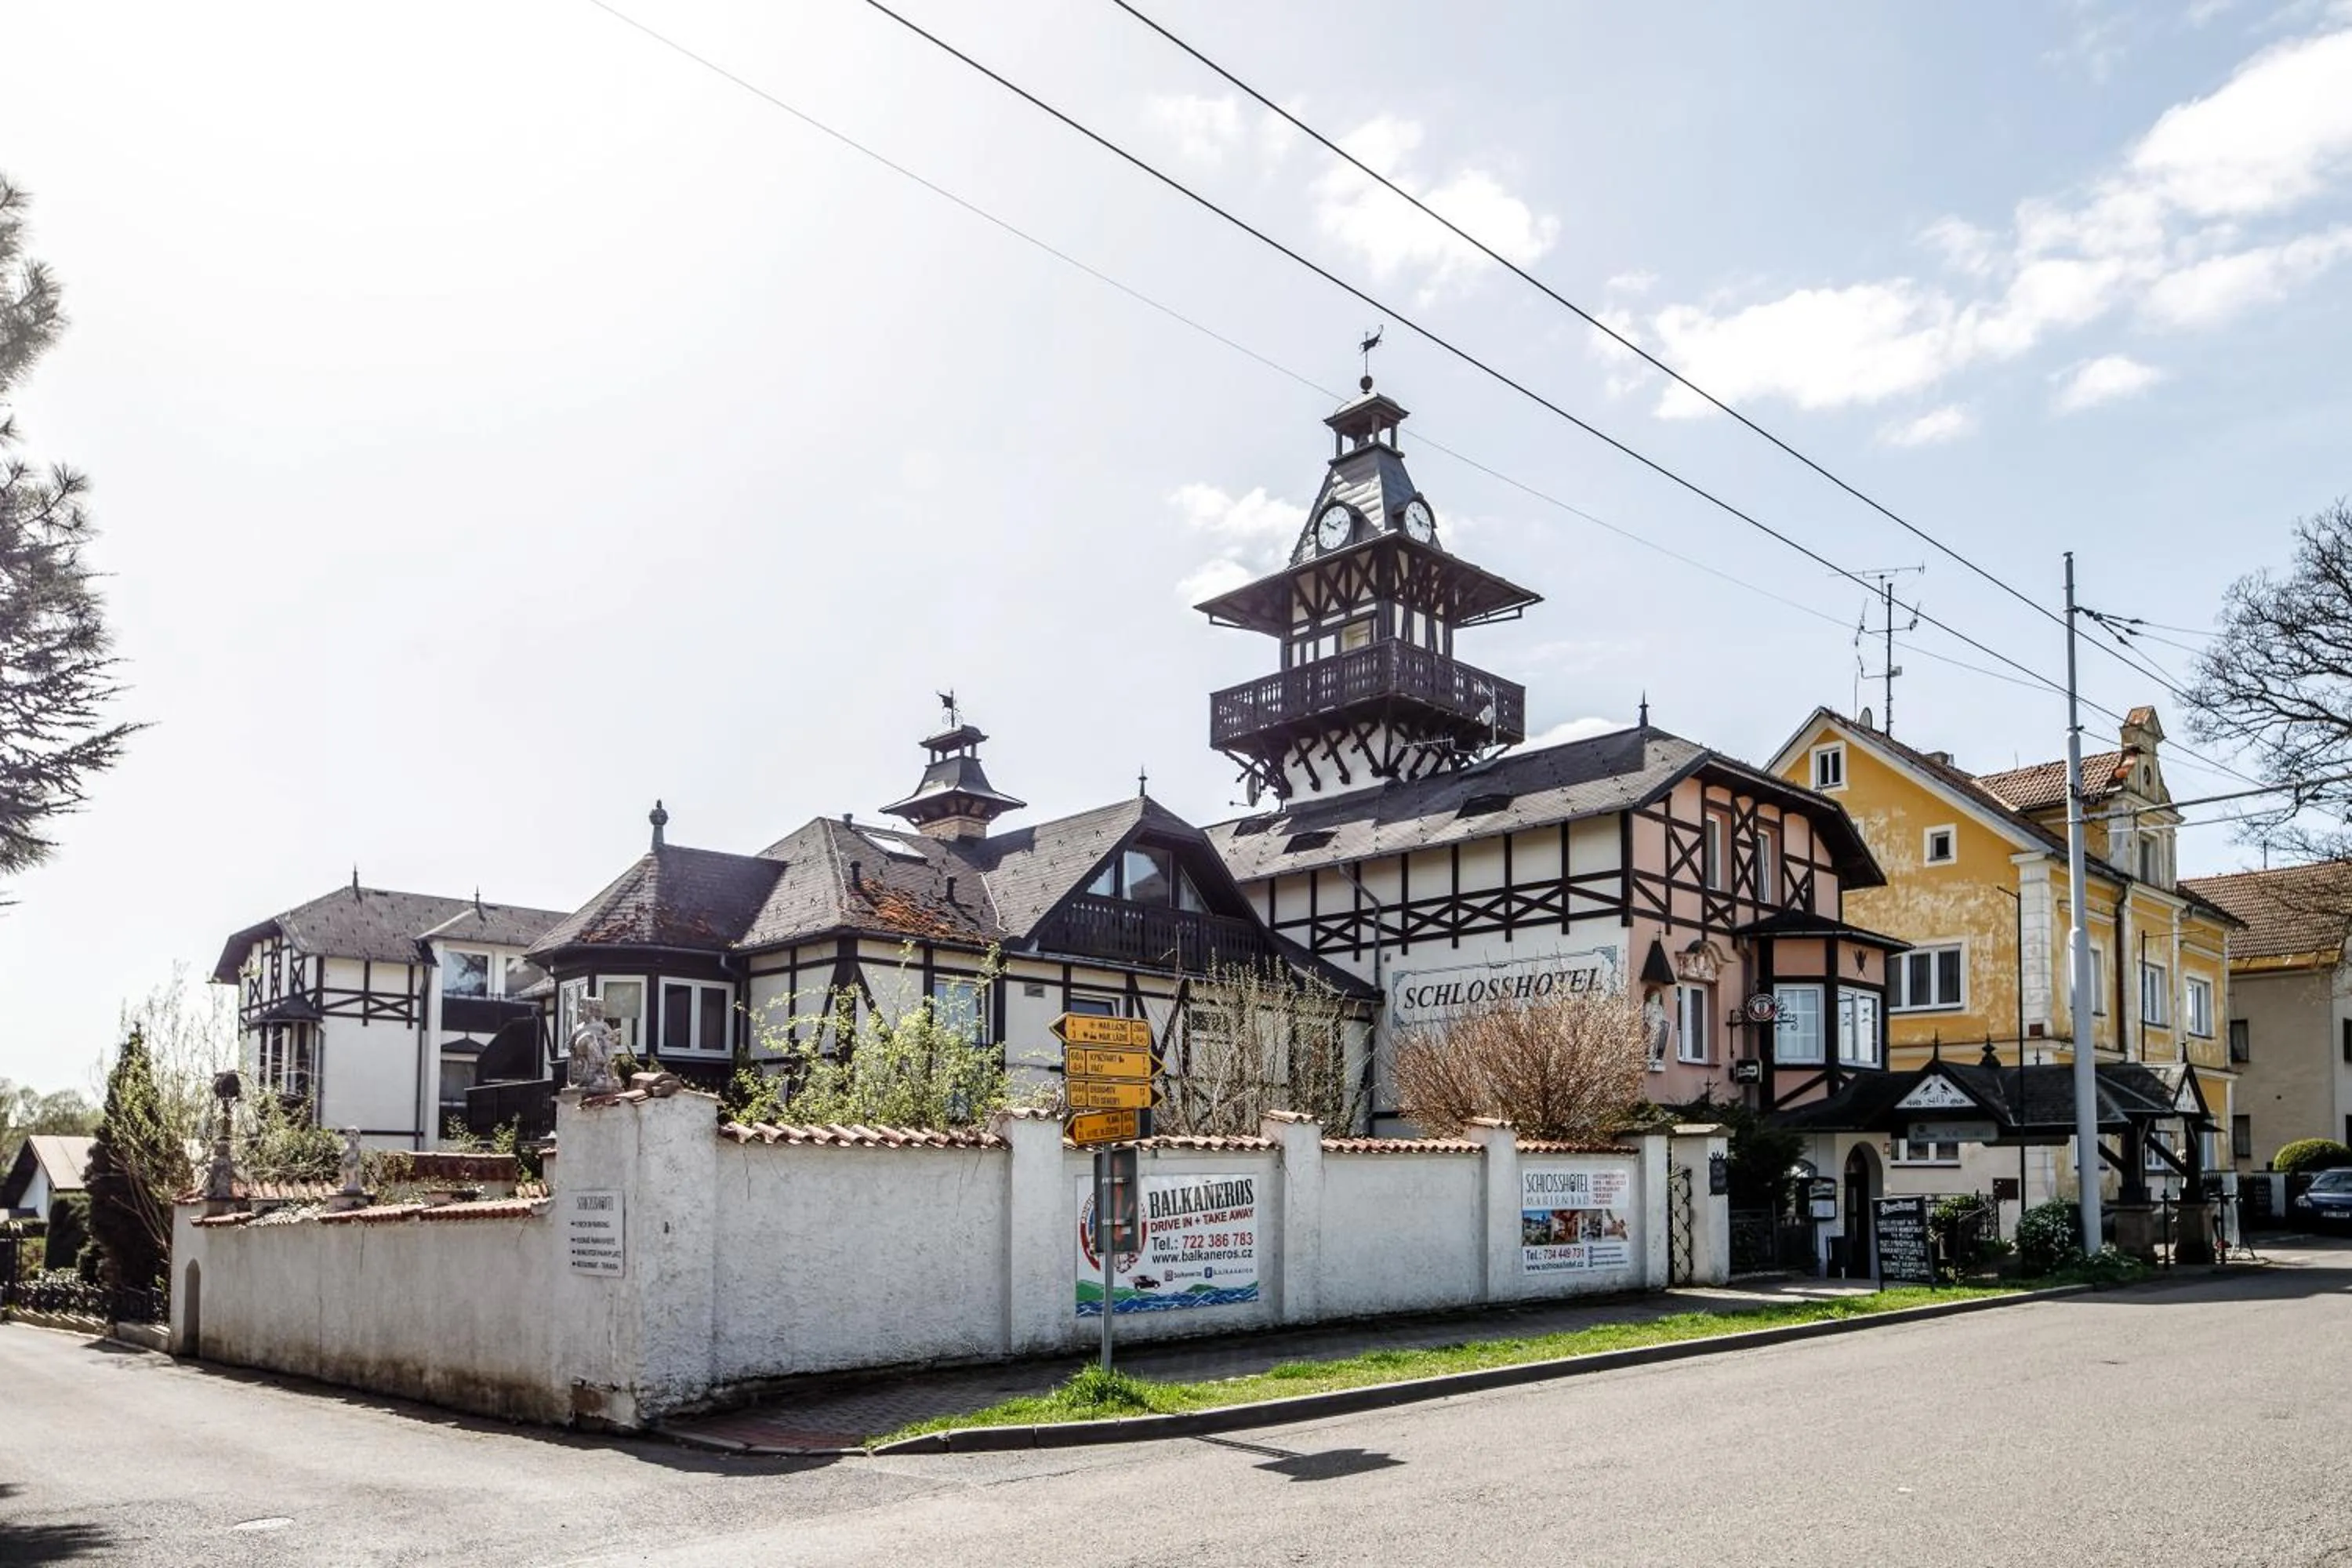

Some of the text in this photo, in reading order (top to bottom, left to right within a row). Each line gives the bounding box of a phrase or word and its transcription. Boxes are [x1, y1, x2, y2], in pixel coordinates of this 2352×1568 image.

[1403, 967, 1603, 1010] SCHLOSSHOTEL
[1525, 1174, 1589, 1192] SCHLOSSHOTEL
[1150, 1220, 1180, 1233] DRIVE
[1183, 1218, 1193, 1229] IN
[1203, 1212, 1227, 1225] TAKE
[1229, 1207, 1254, 1221] AWAY
[1151, 1232, 1254, 1251] Tel.: 722 386 783
[1152, 1248, 1254, 1265] www.balkaneros.cz
